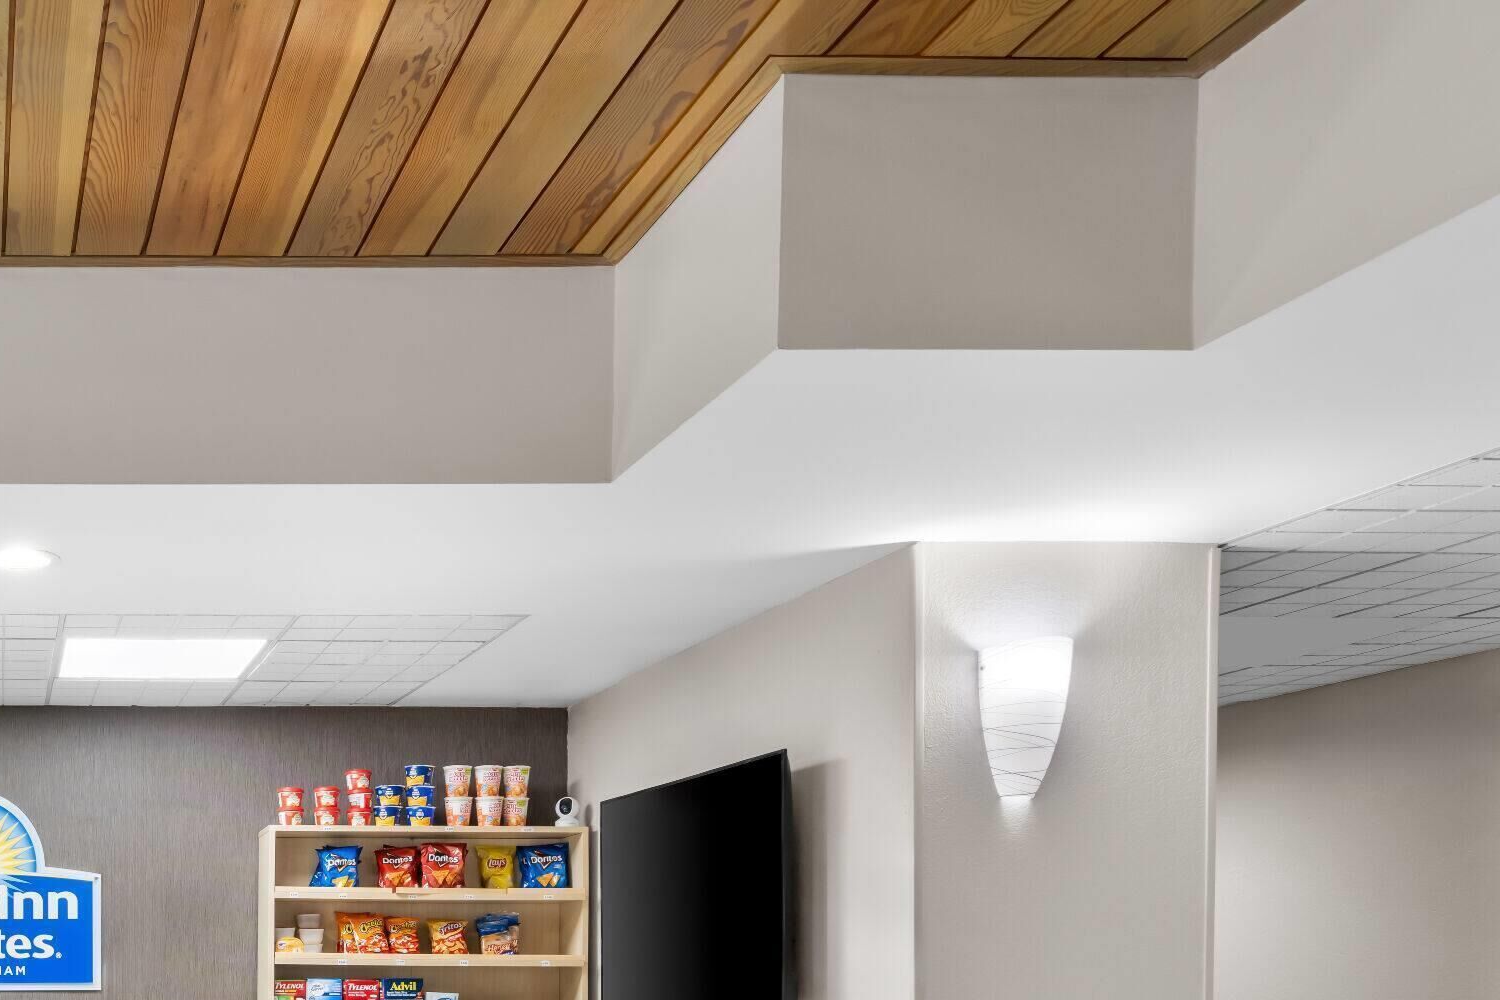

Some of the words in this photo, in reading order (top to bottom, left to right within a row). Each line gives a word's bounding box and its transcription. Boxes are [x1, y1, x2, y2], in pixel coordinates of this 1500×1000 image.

[382, 856, 413, 864] Doritos
[428, 853, 459, 863] Doritos
[530, 855, 563, 864] Doritos
[275, 982, 305, 990] TYLENOL
[348, 983, 378, 991] TYLENOL
[390, 981, 417, 991] Advil
